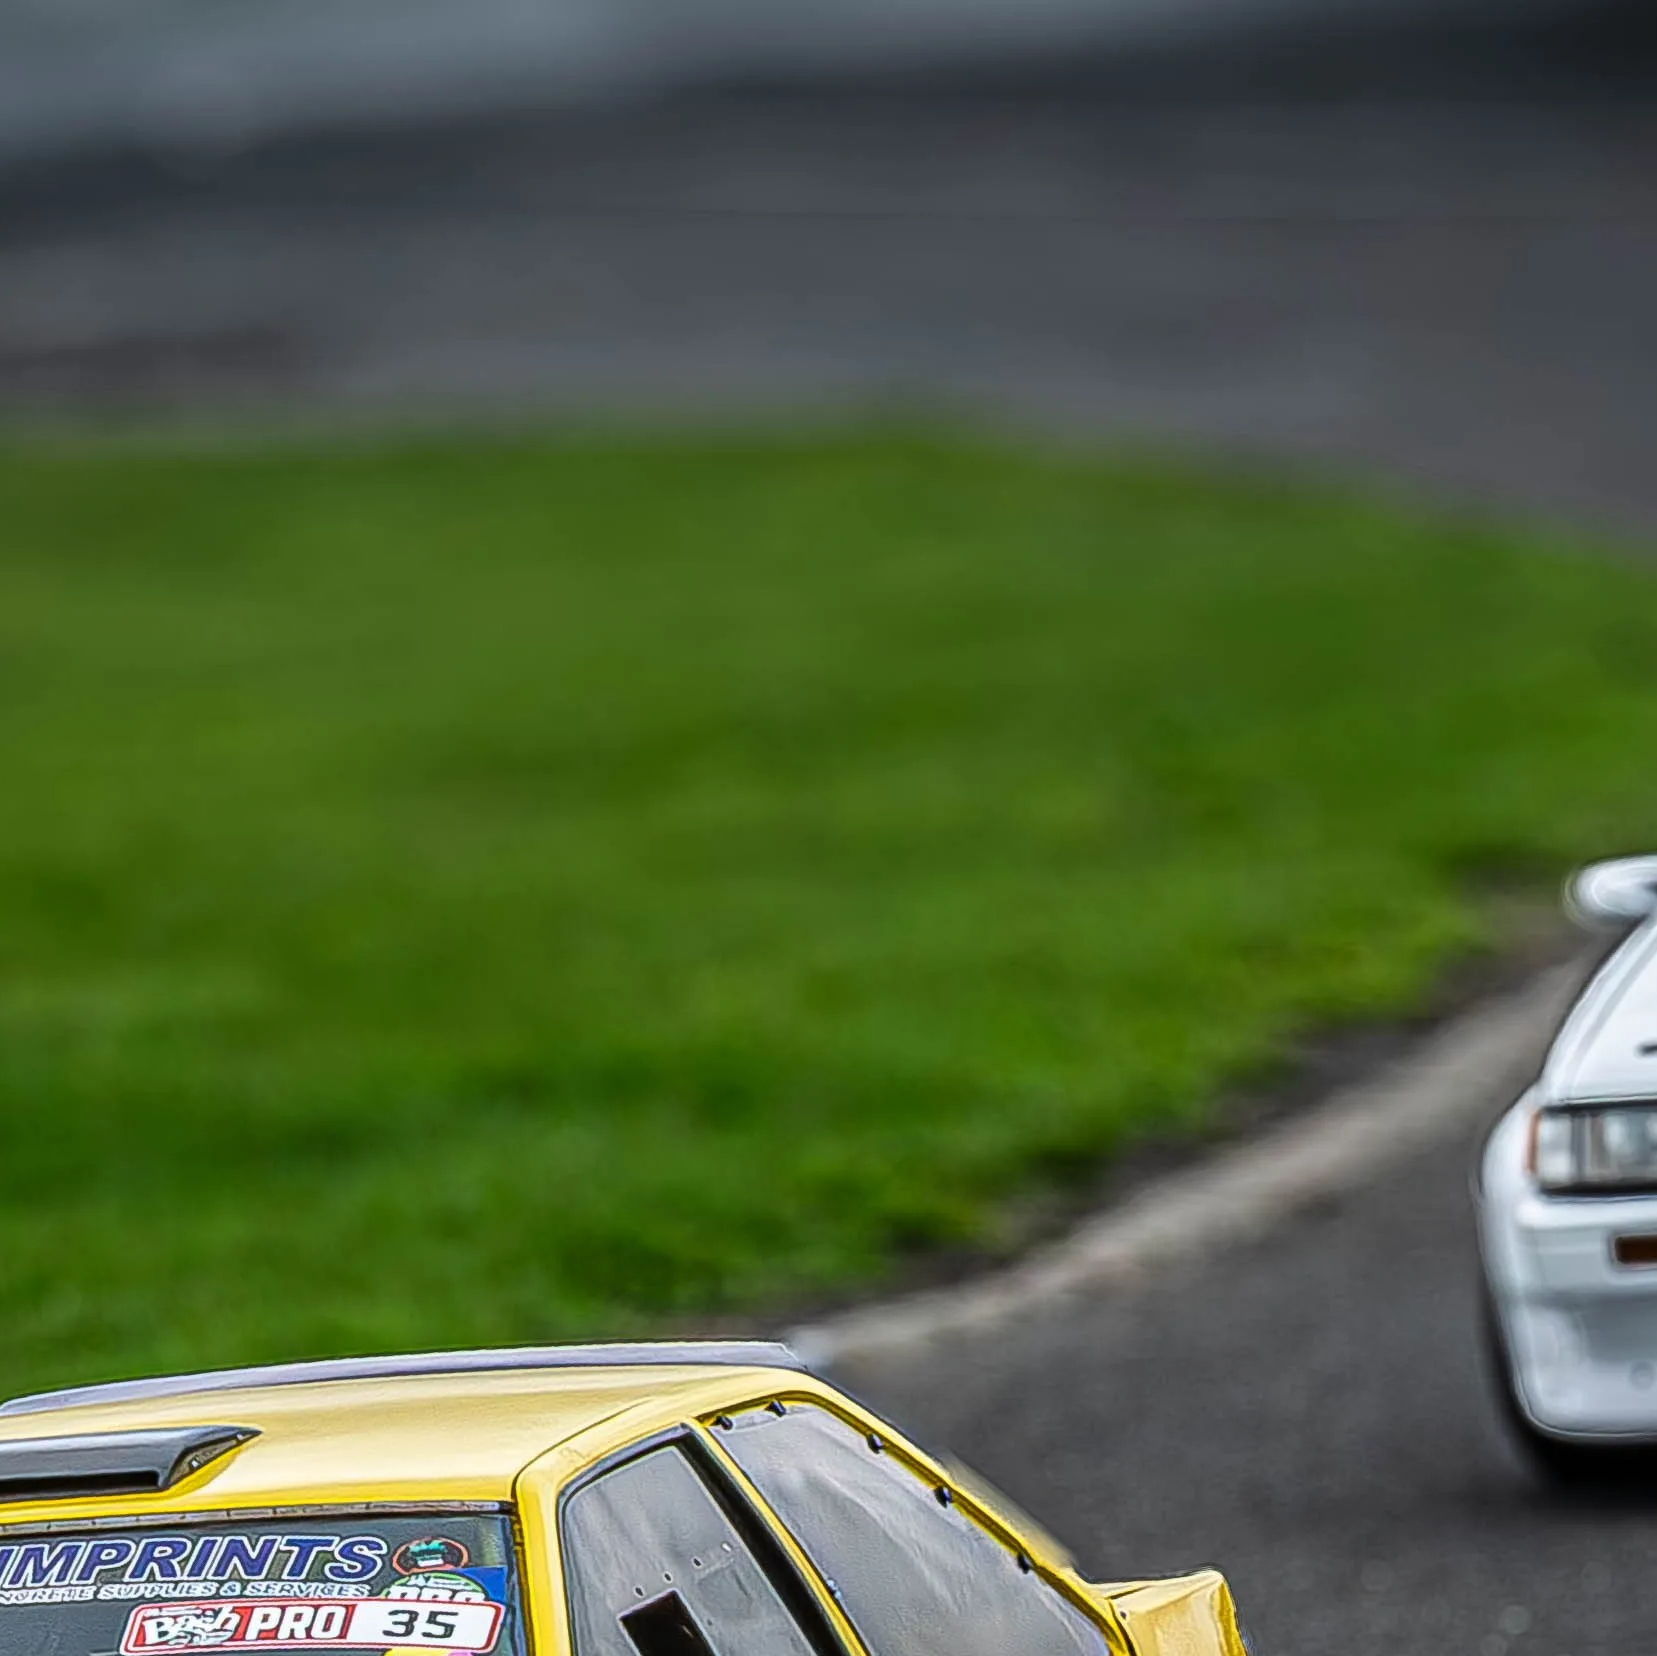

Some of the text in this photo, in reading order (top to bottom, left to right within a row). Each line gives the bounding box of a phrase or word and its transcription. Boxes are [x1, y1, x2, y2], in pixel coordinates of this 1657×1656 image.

[96, 1581, 219, 1600] SUPPLIES
[219, 1581, 241, 1597] &
[243, 1581, 373, 1598] SERVICES
[245, 1604, 345, 1641] PRO
[382, 1609, 459, 1639] 35
